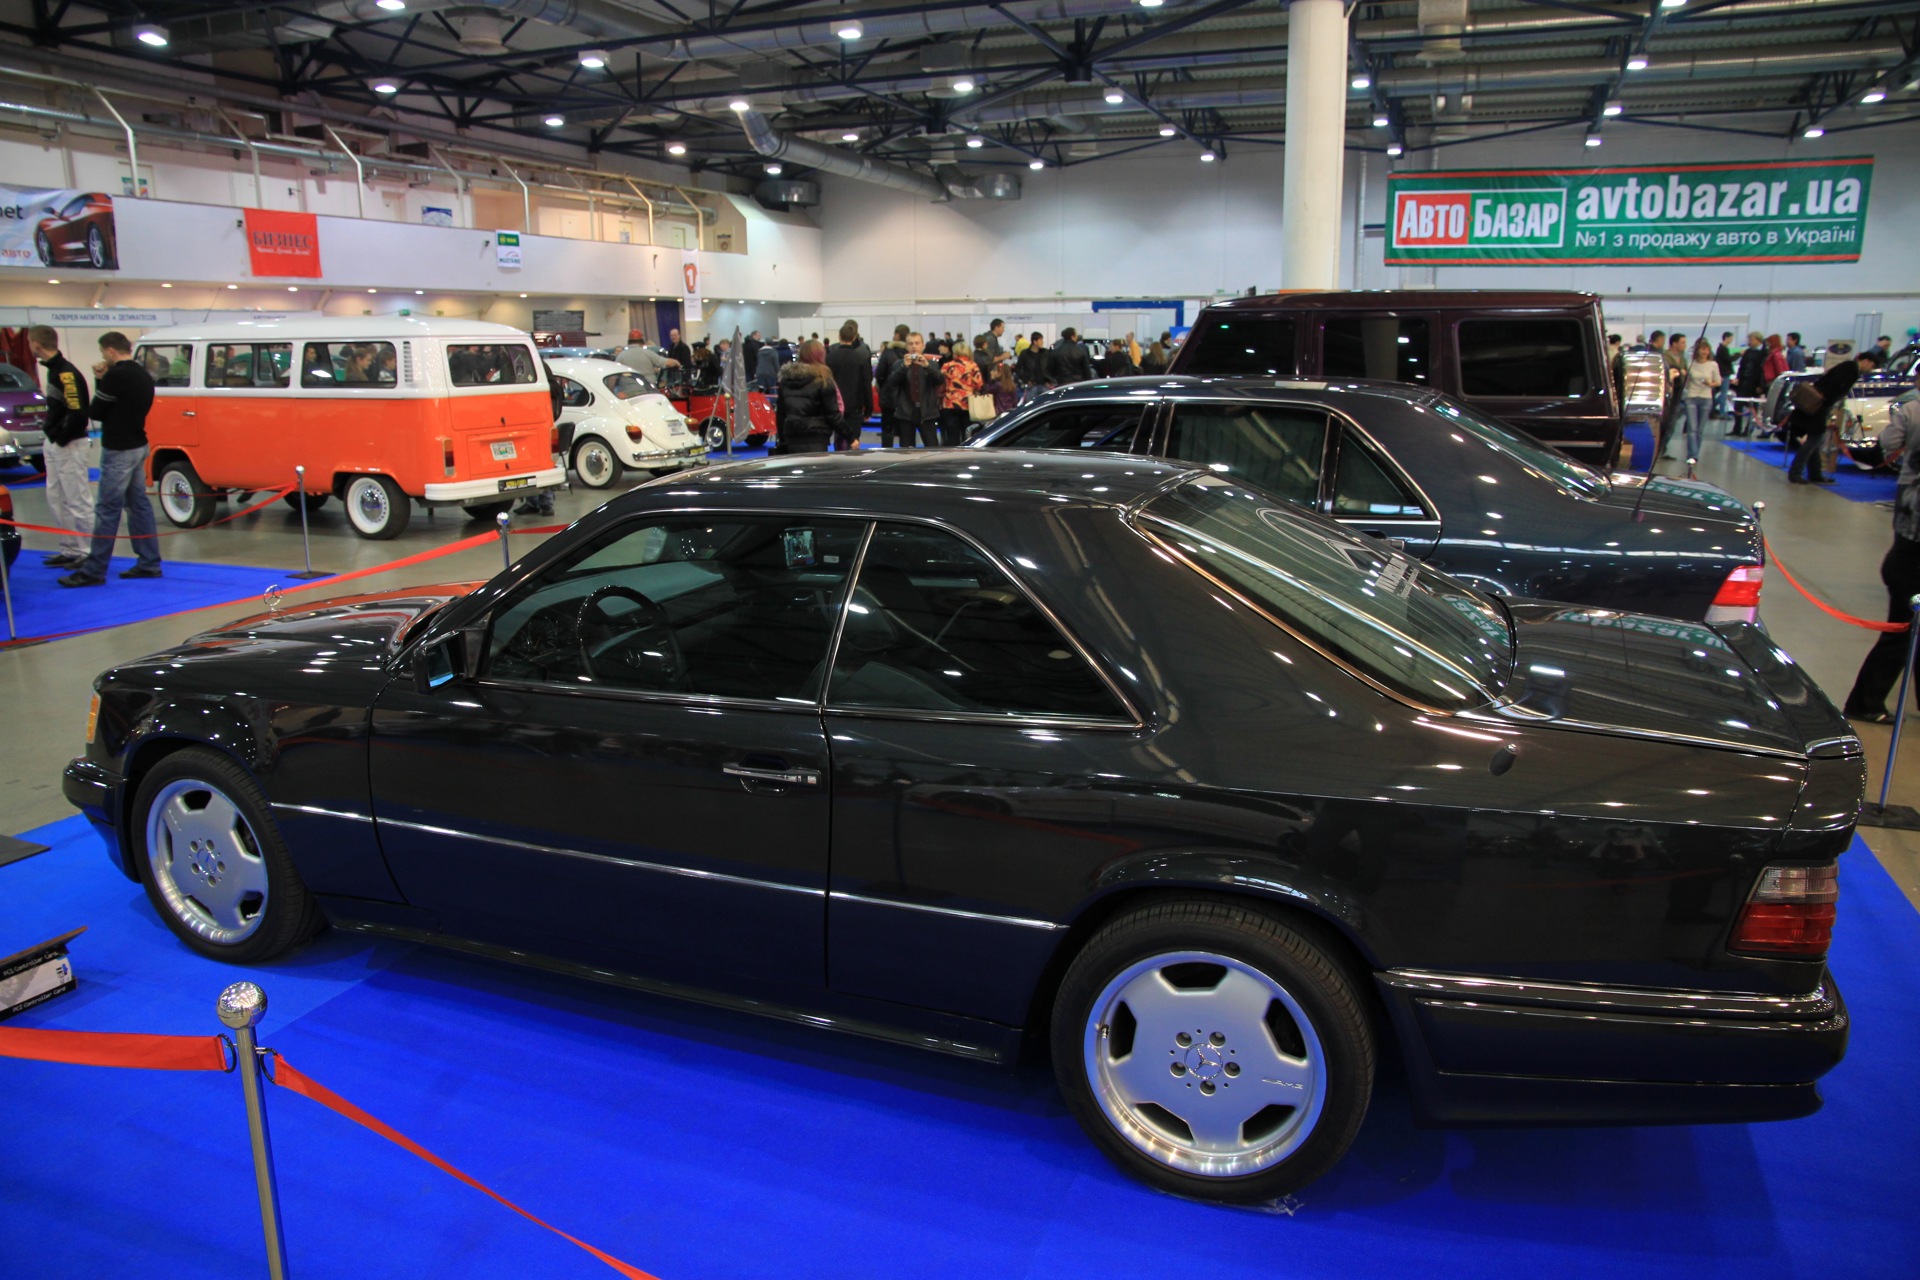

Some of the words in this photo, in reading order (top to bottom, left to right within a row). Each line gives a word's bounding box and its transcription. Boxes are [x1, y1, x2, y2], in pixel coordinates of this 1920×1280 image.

[1575, 174, 1862, 221] avtobazar.ua
[253, 230, 314, 249] БИЗНЕС
[1576, 230, 1606, 247] №1
[1628, 231, 1712, 250] продажу
[1716, 231, 1761, 245] авто
[1766, 231, 1778, 244] в
[1785, 225, 1856, 247] Україні
[14, 957, 43, 972] Controller
[23, 992, 53, 1008] Controller
[53, 986, 66, 995] Card
